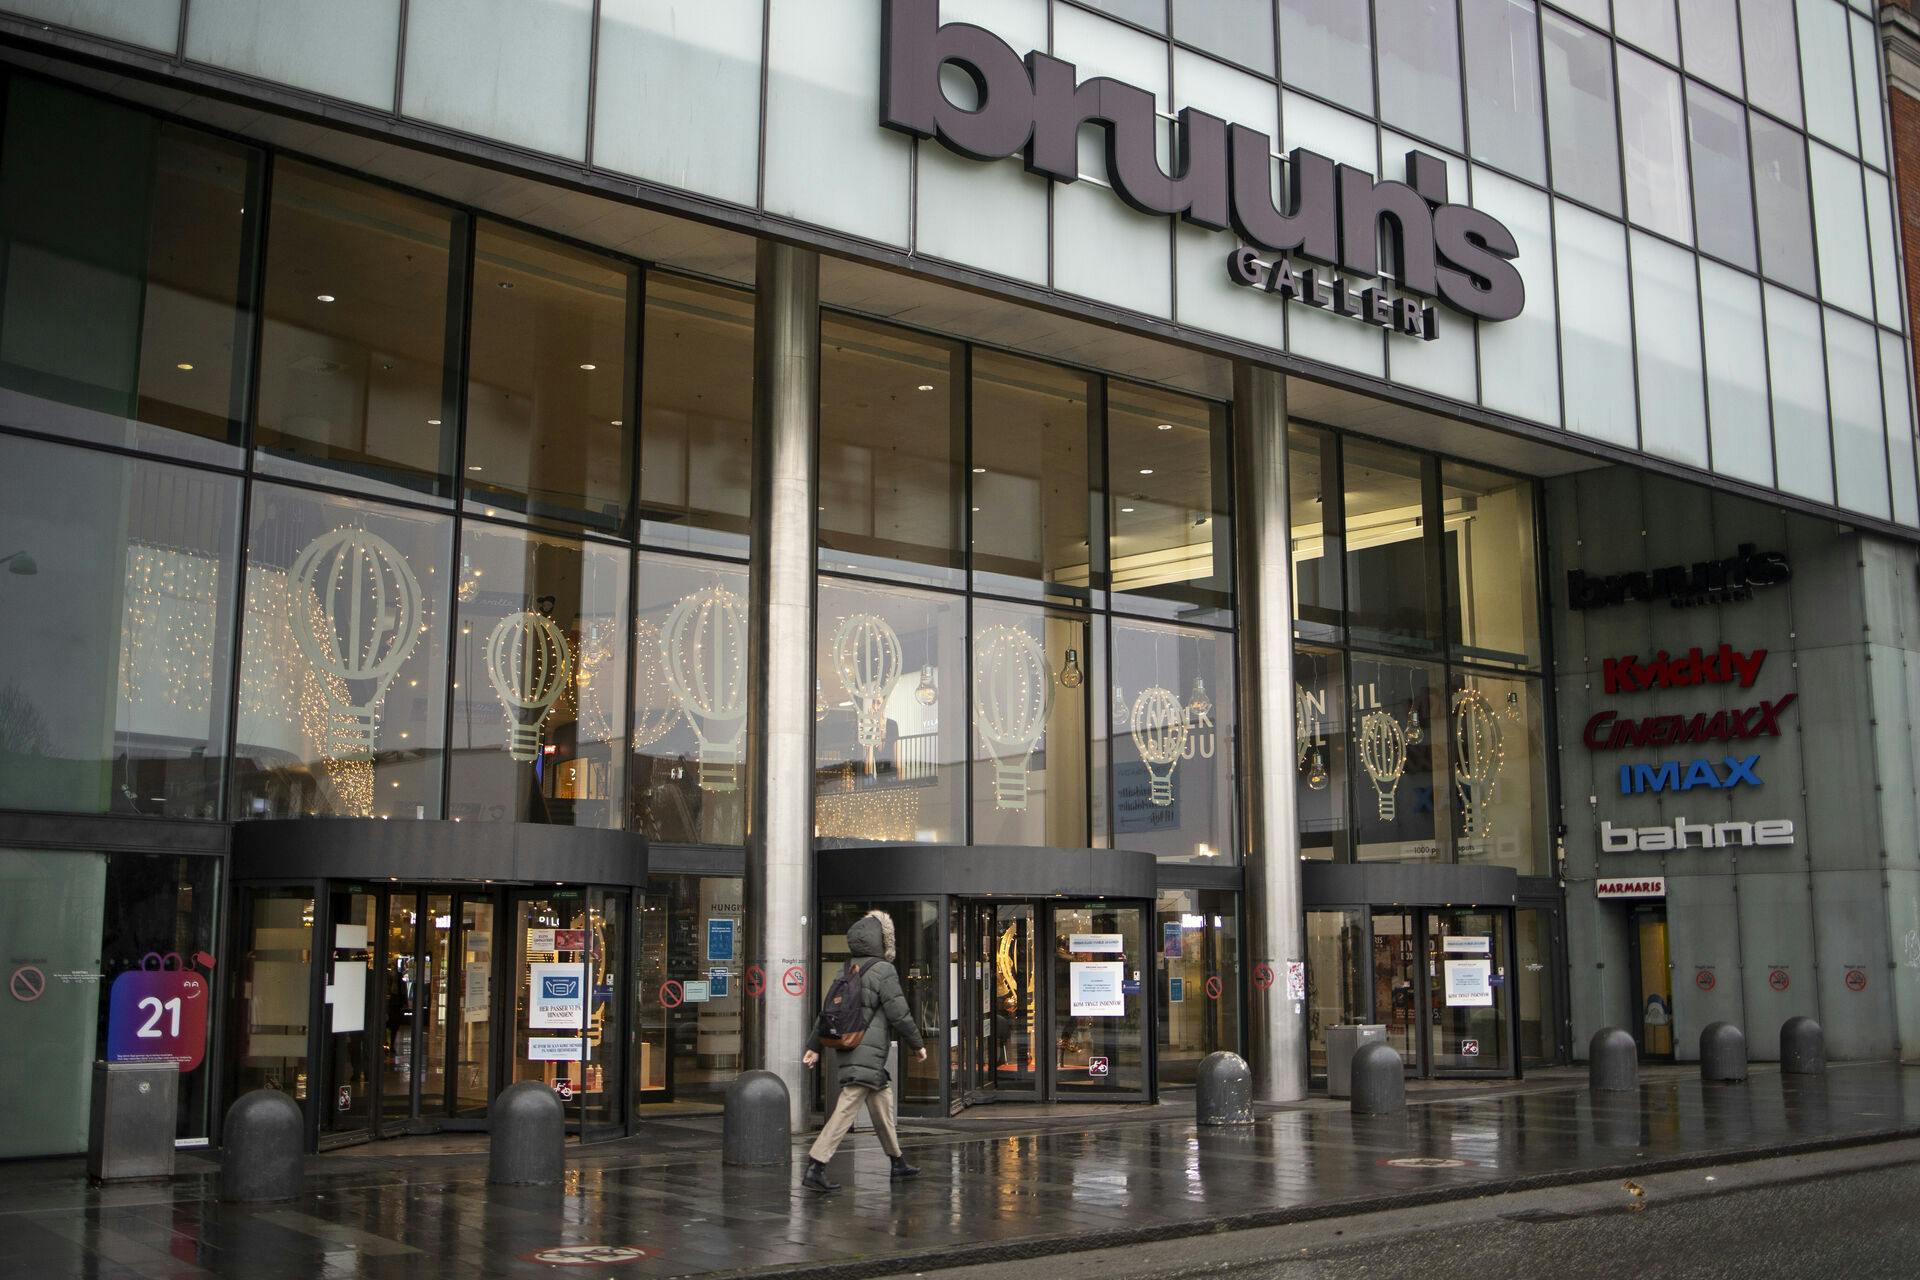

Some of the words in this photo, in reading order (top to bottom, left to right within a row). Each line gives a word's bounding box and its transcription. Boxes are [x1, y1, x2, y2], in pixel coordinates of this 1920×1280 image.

[880, 0, 1525, 321] bruun's
[1227, 245, 1439, 341] GALLERI
[1603, 643, 1767, 694] Kvickly
[1620, 755, 1765, 794] IMAX
[1601, 817, 1794, 852] bahne
[1598, 881, 1661, 893] MARMARIS
[137, 997, 181, 1037] 21
